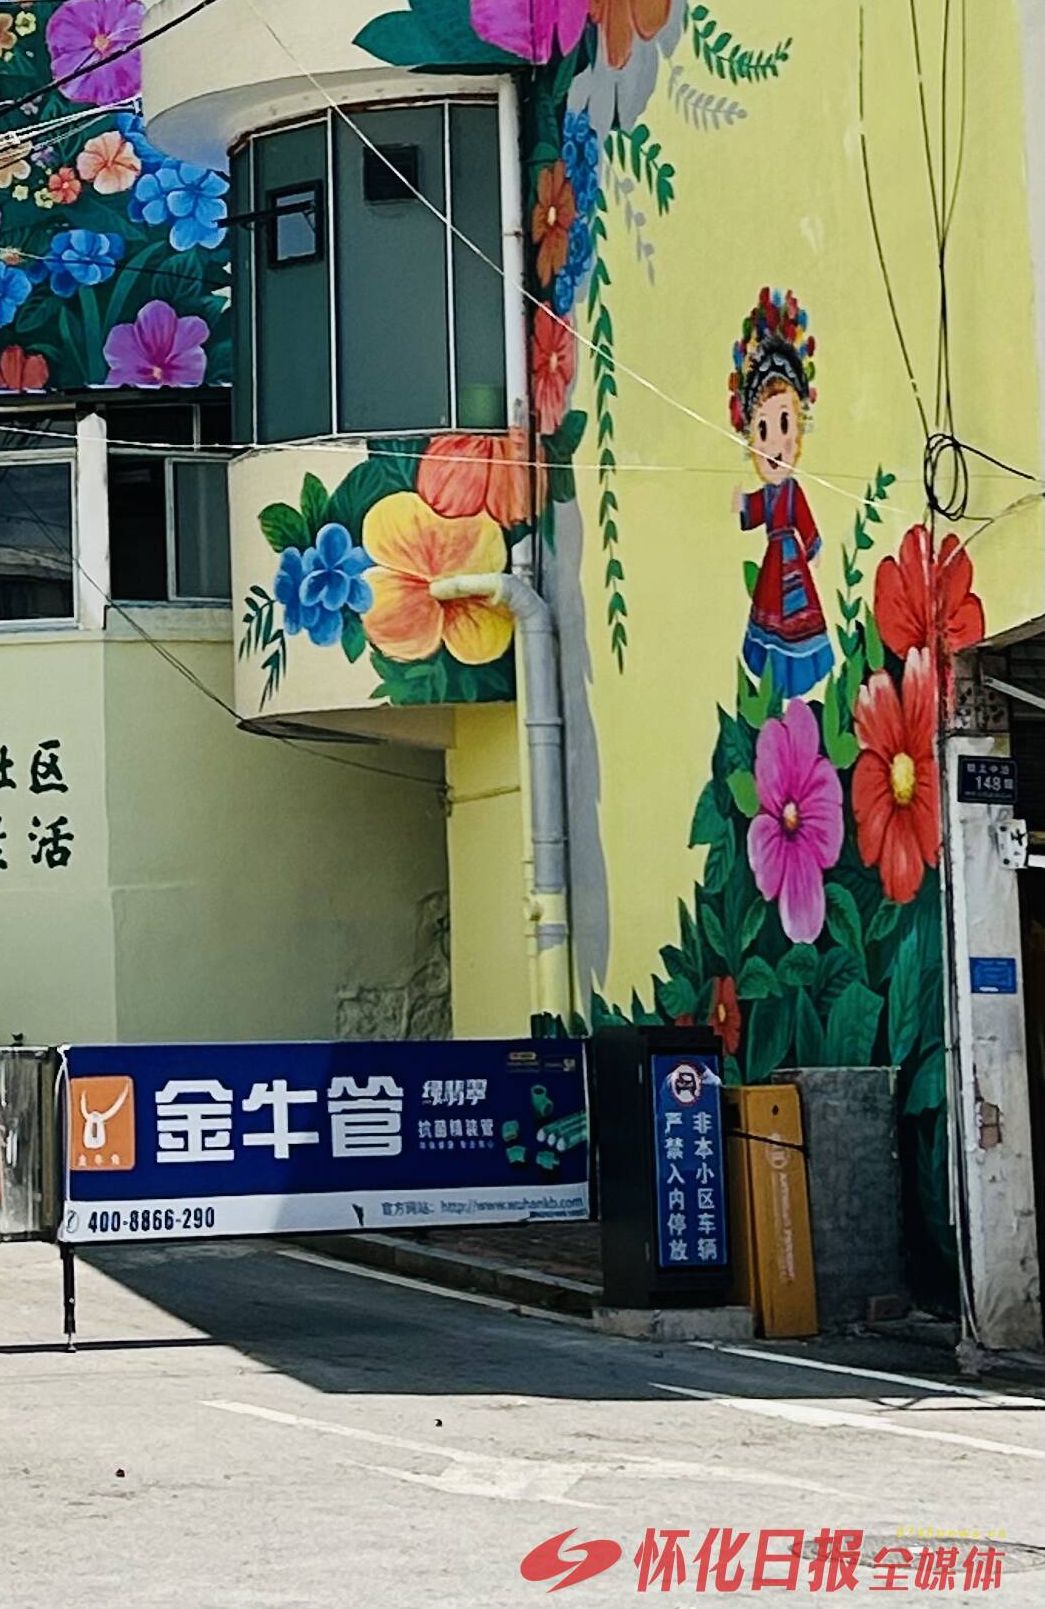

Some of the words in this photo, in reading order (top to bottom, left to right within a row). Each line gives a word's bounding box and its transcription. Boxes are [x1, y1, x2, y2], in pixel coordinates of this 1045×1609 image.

[155, 1076, 404, 1163] 金牛管
[88, 1207, 215, 1233] 400-8866-290
[664, 1111, 689, 1262] 严禁入内停放
[692, 1111, 718, 1261] 非本小区车辆
